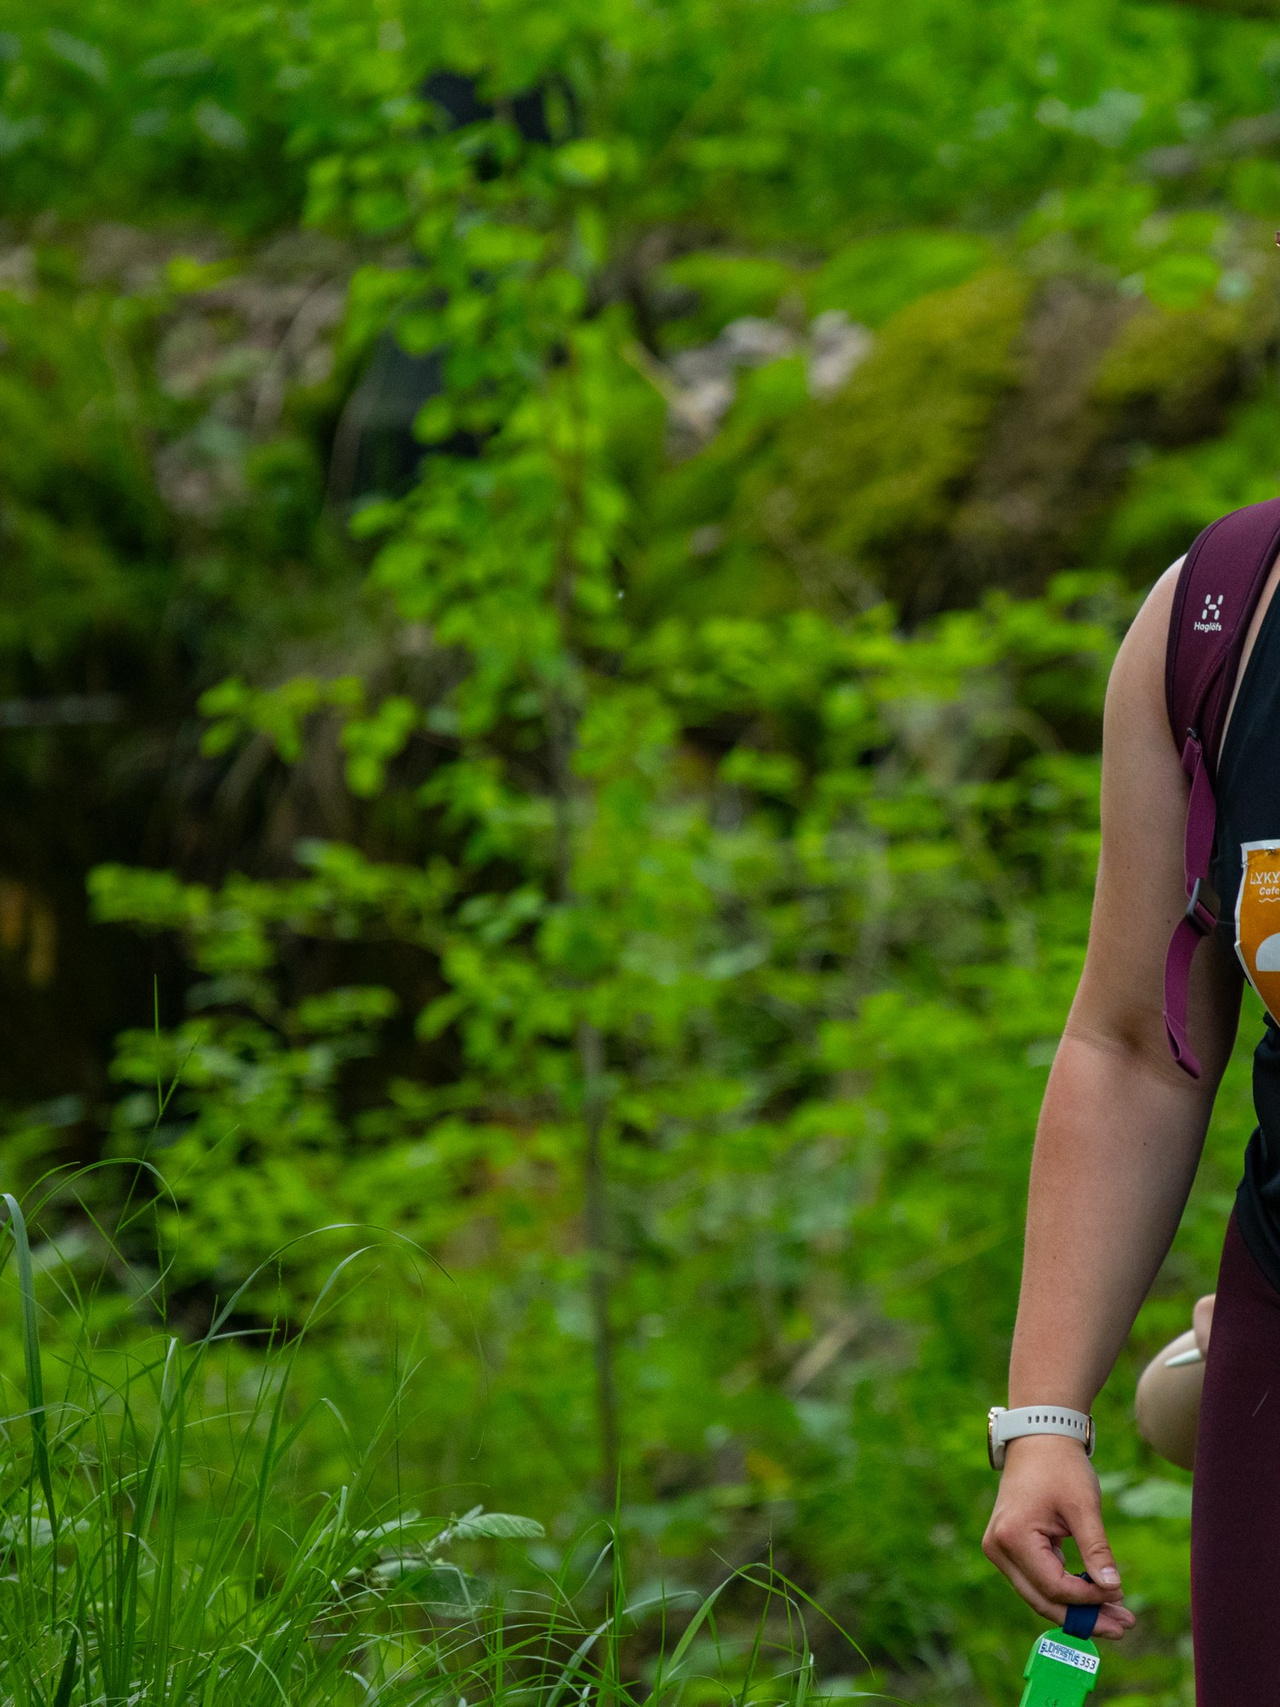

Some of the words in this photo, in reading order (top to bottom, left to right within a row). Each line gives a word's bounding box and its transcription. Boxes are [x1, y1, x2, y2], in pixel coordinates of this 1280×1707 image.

[1193, 621, 1222, 633] Haglöfs
[1259, 886, 1280, 896] Cafe
[1080, 1656, 1097, 1670] 353
